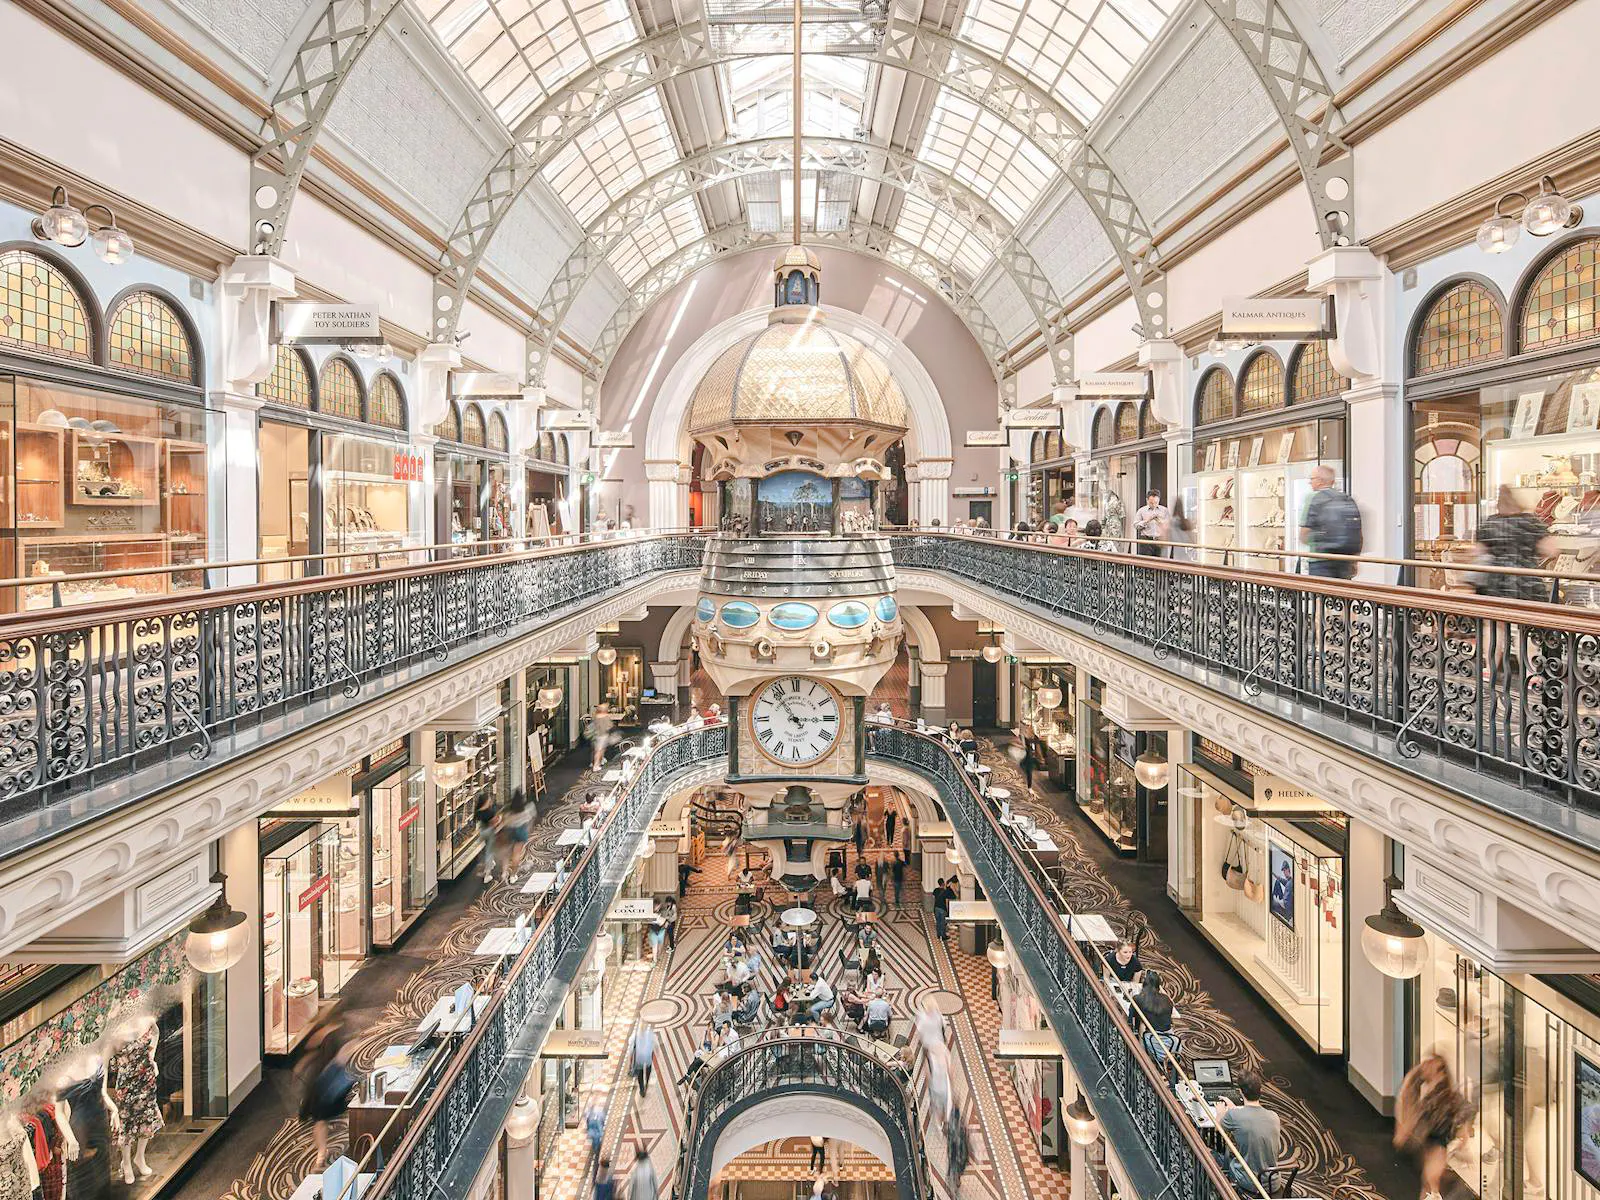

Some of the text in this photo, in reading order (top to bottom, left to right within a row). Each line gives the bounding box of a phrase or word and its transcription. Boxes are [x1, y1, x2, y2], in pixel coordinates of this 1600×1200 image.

[312, 311, 371, 319] PETER NATHAN
[394, 462, 423, 476] SALE
[742, 570, 769, 579] FRIDAY
